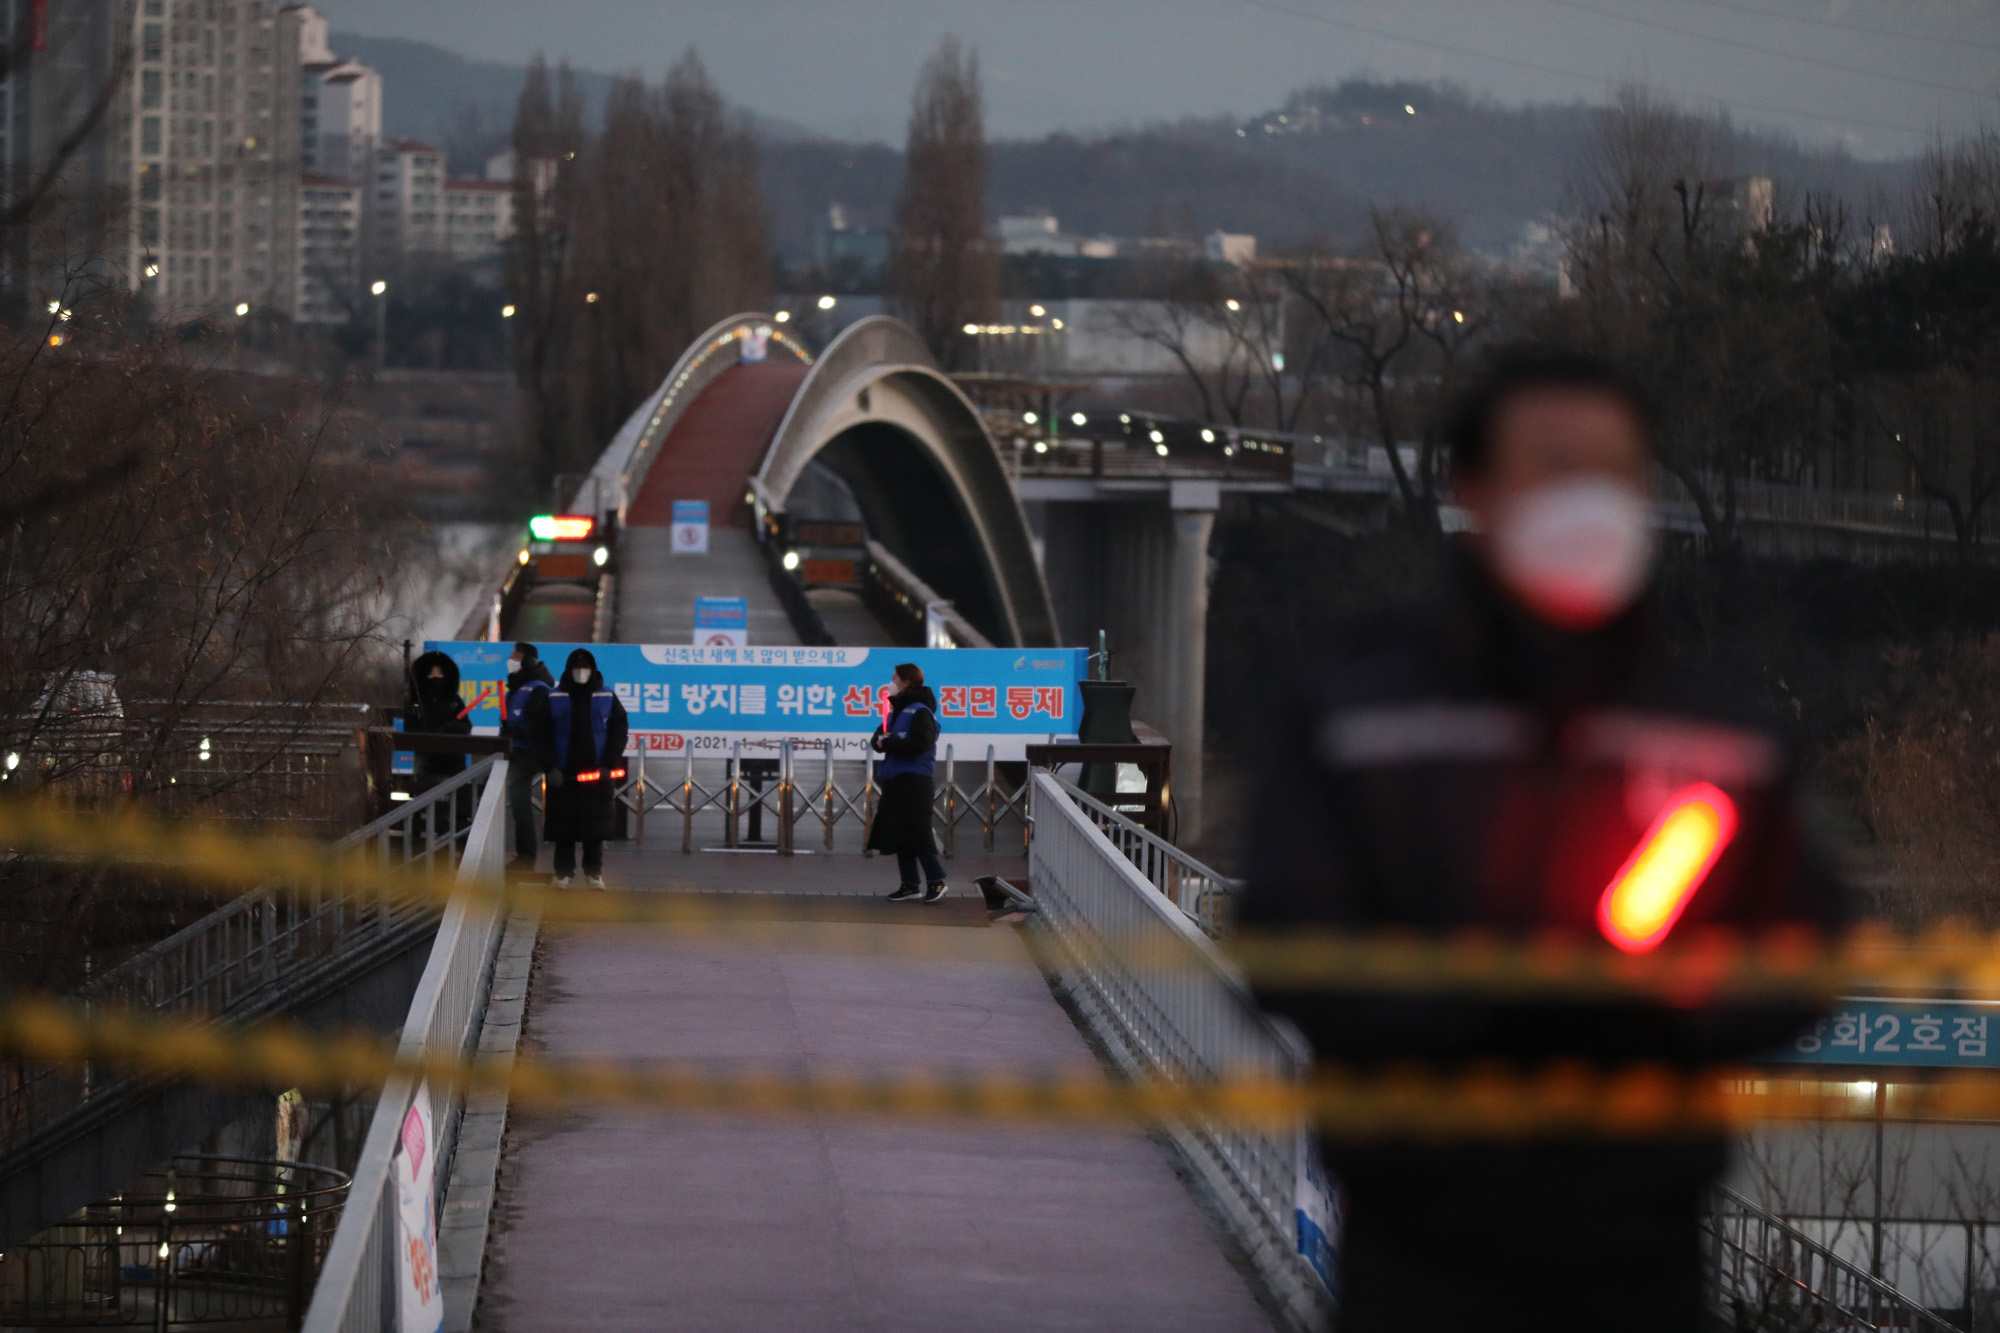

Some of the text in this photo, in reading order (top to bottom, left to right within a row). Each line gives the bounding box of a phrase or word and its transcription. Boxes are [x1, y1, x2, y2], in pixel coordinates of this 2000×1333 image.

[664, 648, 847, 664] 신축년 새해 복 많이 받으세요
[614, 683, 670, 713] 밀집
[681, 684, 766, 715] 방지를
[777, 684, 836, 716] 위한
[940, 686, 996, 718] 전면
[1006, 686, 1064, 720] 통제
[694, 736, 732, 750] 2021.
